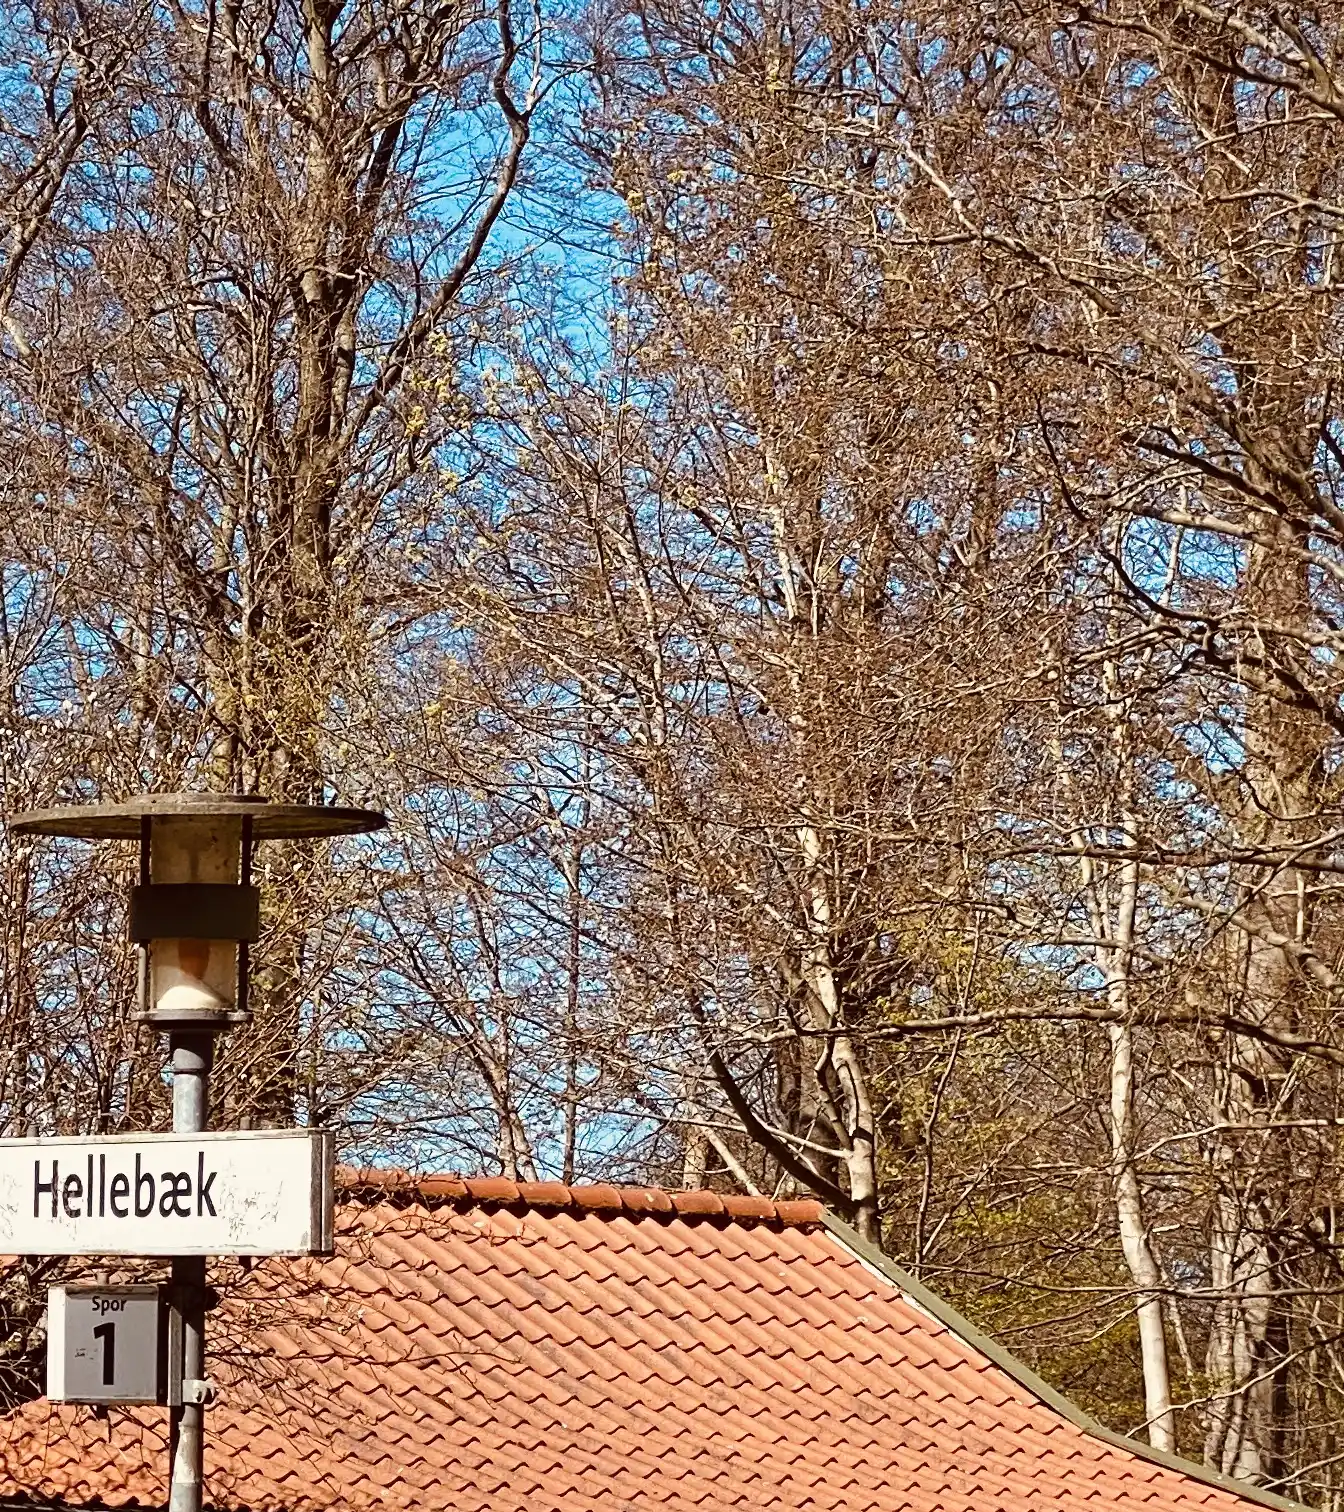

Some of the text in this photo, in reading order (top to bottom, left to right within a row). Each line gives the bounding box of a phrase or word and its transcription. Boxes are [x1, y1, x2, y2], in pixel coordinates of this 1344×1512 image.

[33, 1151, 217, 1219] Hellebæk
[91, 1295, 127, 1317] Spor
[93, 1321, 115, 1386] 1
